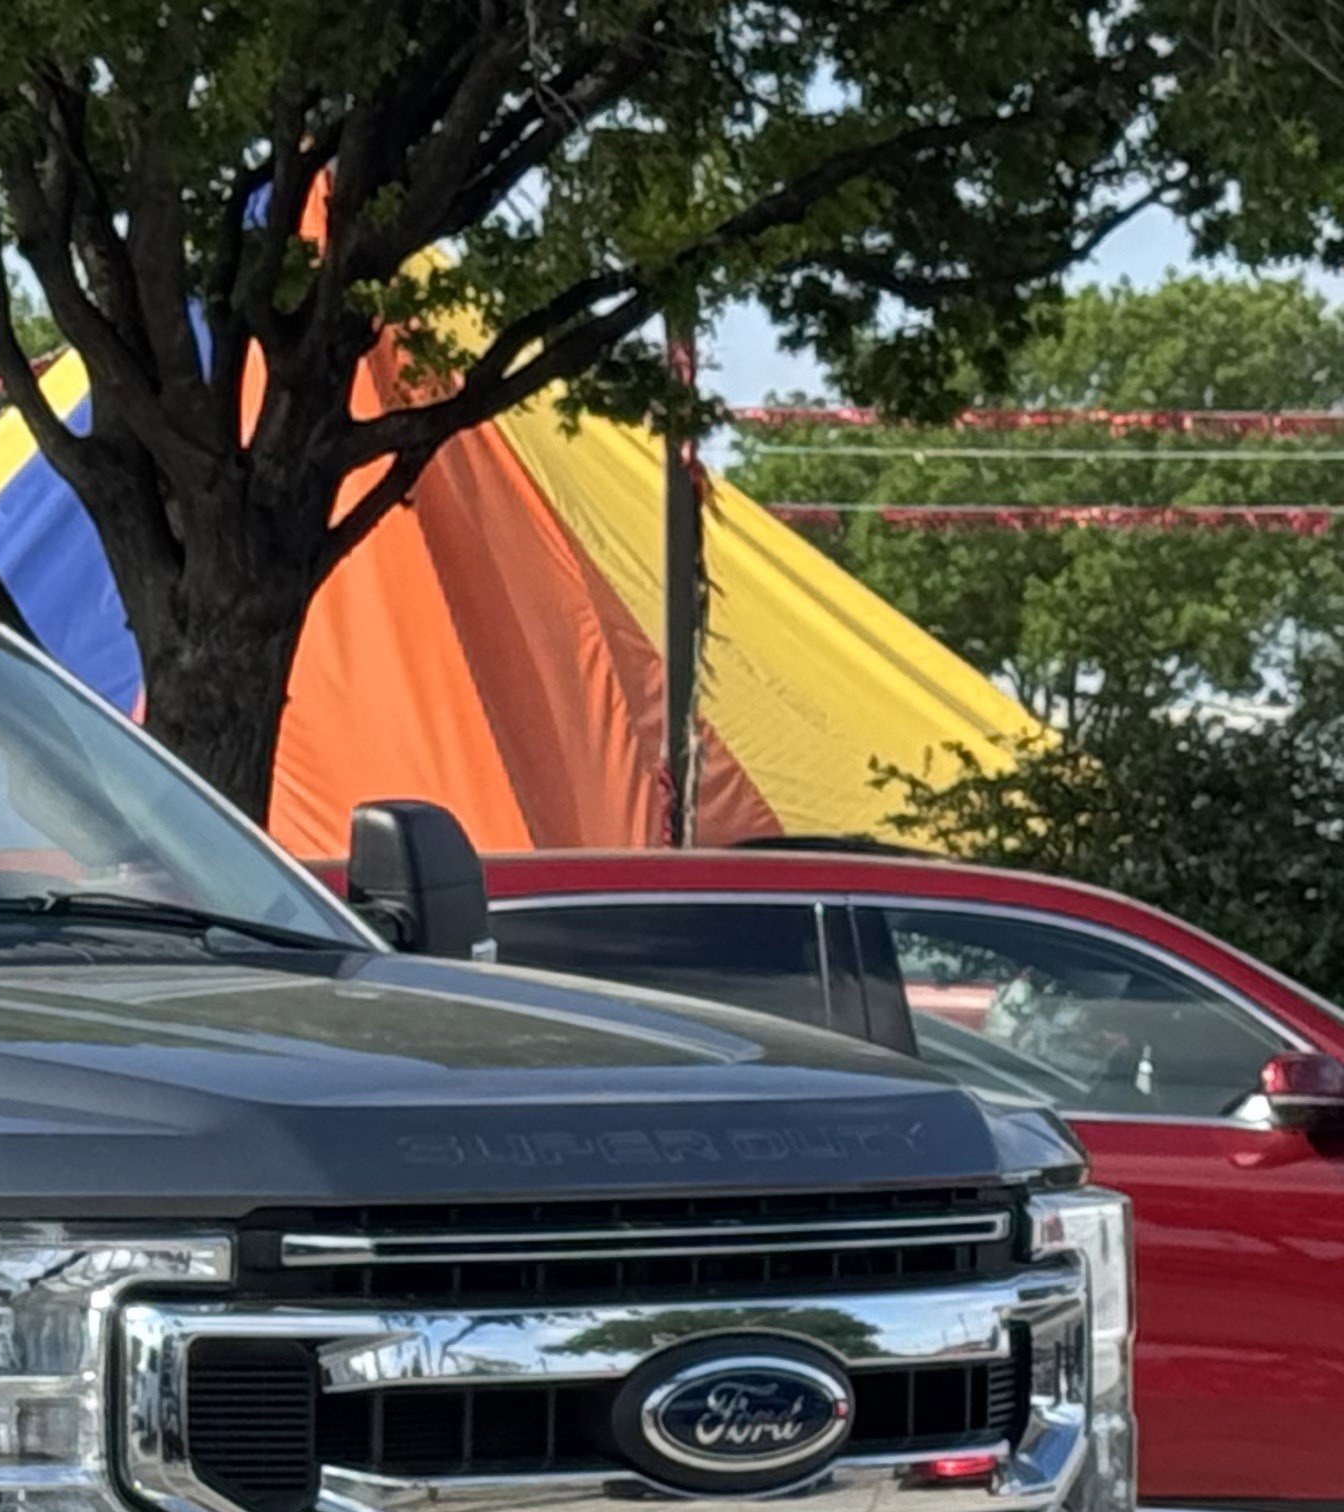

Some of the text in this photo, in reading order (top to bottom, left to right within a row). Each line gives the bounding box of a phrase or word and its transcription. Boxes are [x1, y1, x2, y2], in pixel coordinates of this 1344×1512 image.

[397, 1119, 926, 1168] SUPER DUTY
[694, 1380, 804, 1446] Ford
